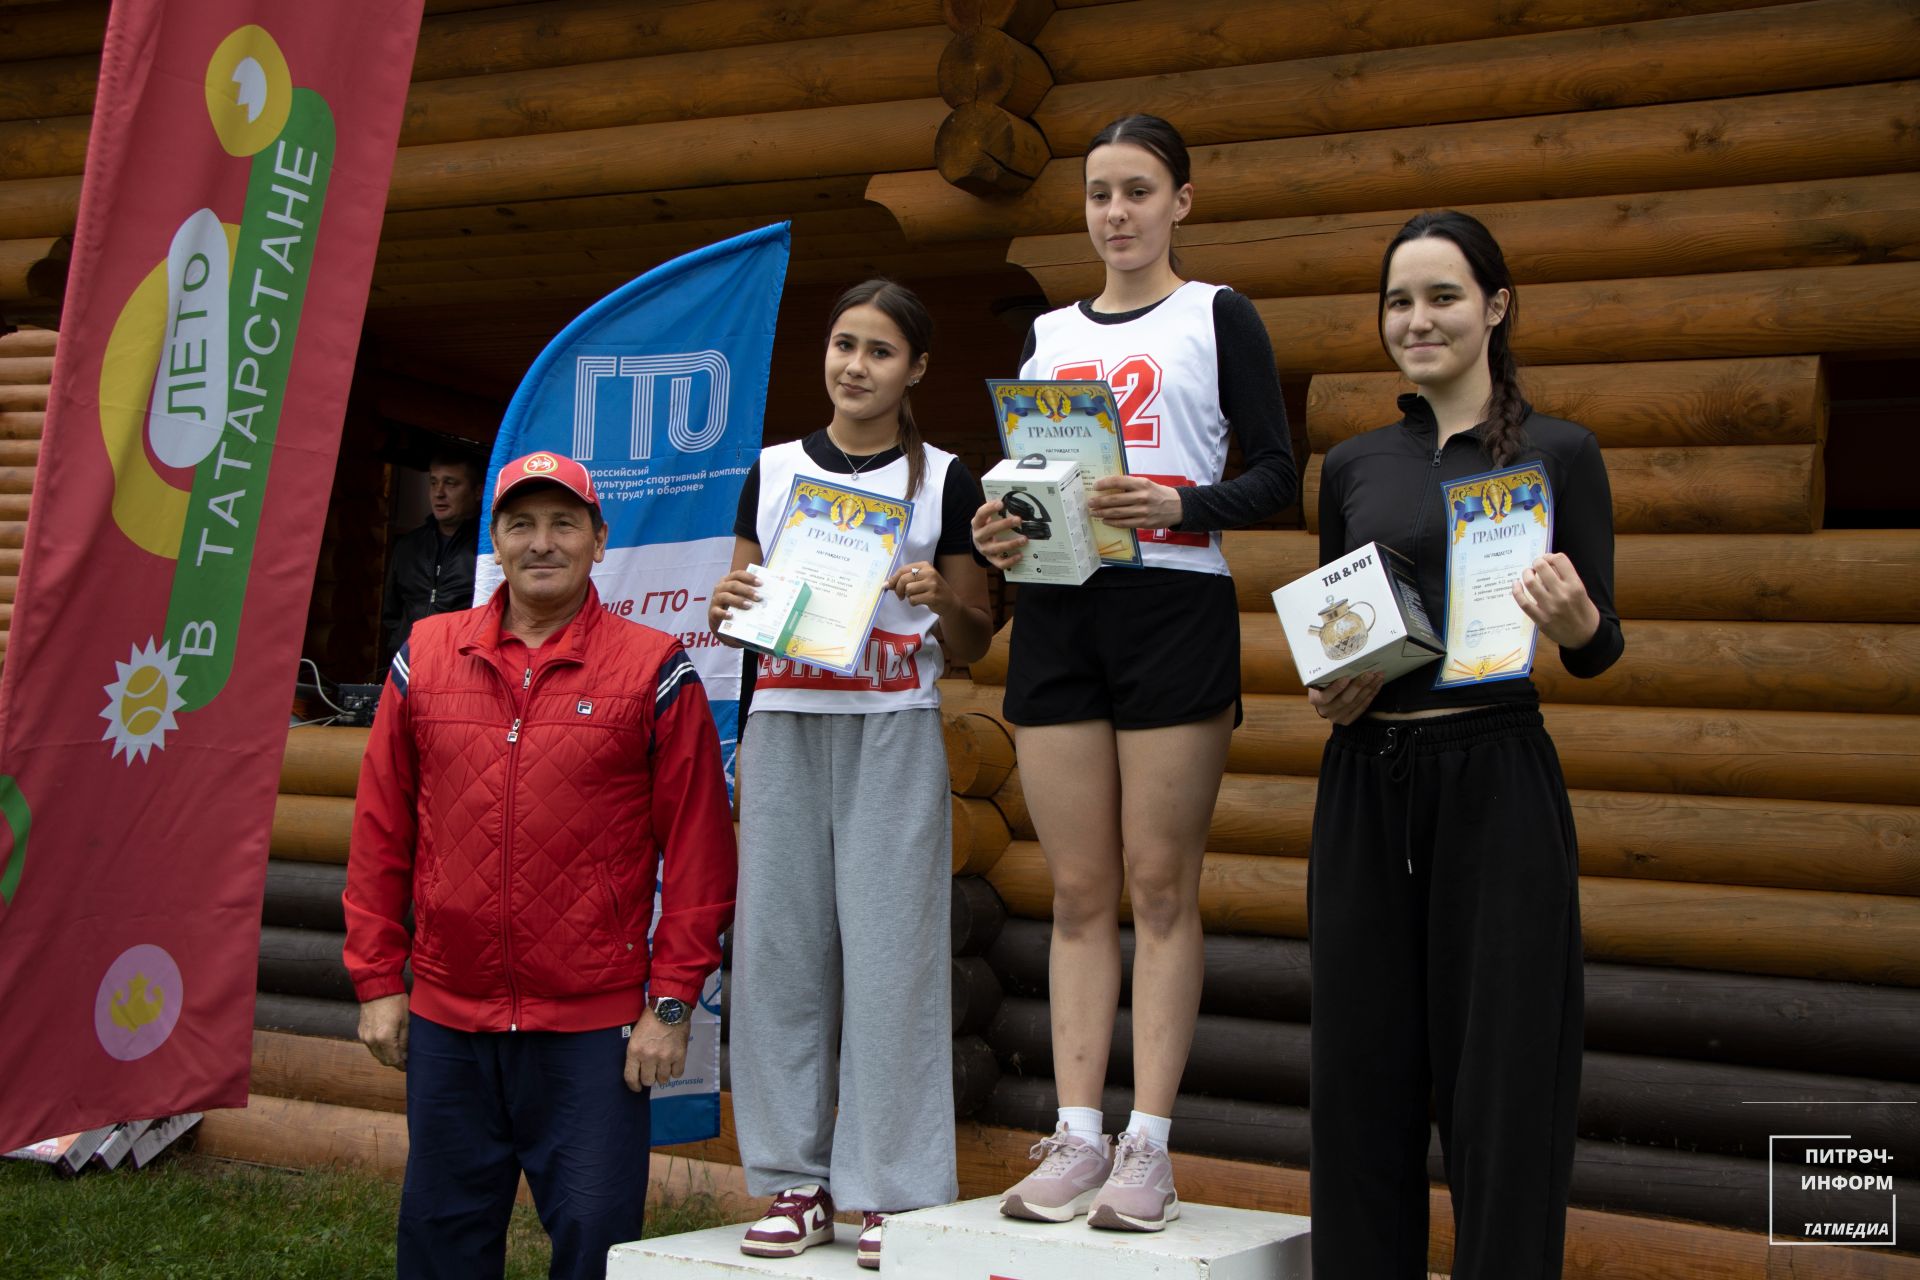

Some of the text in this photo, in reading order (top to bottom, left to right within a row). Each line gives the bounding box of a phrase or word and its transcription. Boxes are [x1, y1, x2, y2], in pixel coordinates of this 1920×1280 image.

[168, 252, 211, 422] ЛЕТО
[178, 139, 319, 658] В ТАТАРСТАНЕ
[573, 350, 730, 460] ГТО
[1051, 353, 1163, 449] 2
[1027, 425, 1093, 439] ГРАМОТА
[589, 465, 650, 478] российский
[616, 489, 645, 501] труду
[657, 482, 704, 496] обороне»
[807, 527, 870, 553] ГРАМОТА
[1472, 522, 1527, 544] ГРАМОТА
[1321, 554, 1373, 587] TEA & POT
[641, 588, 689, 615] ГТО
